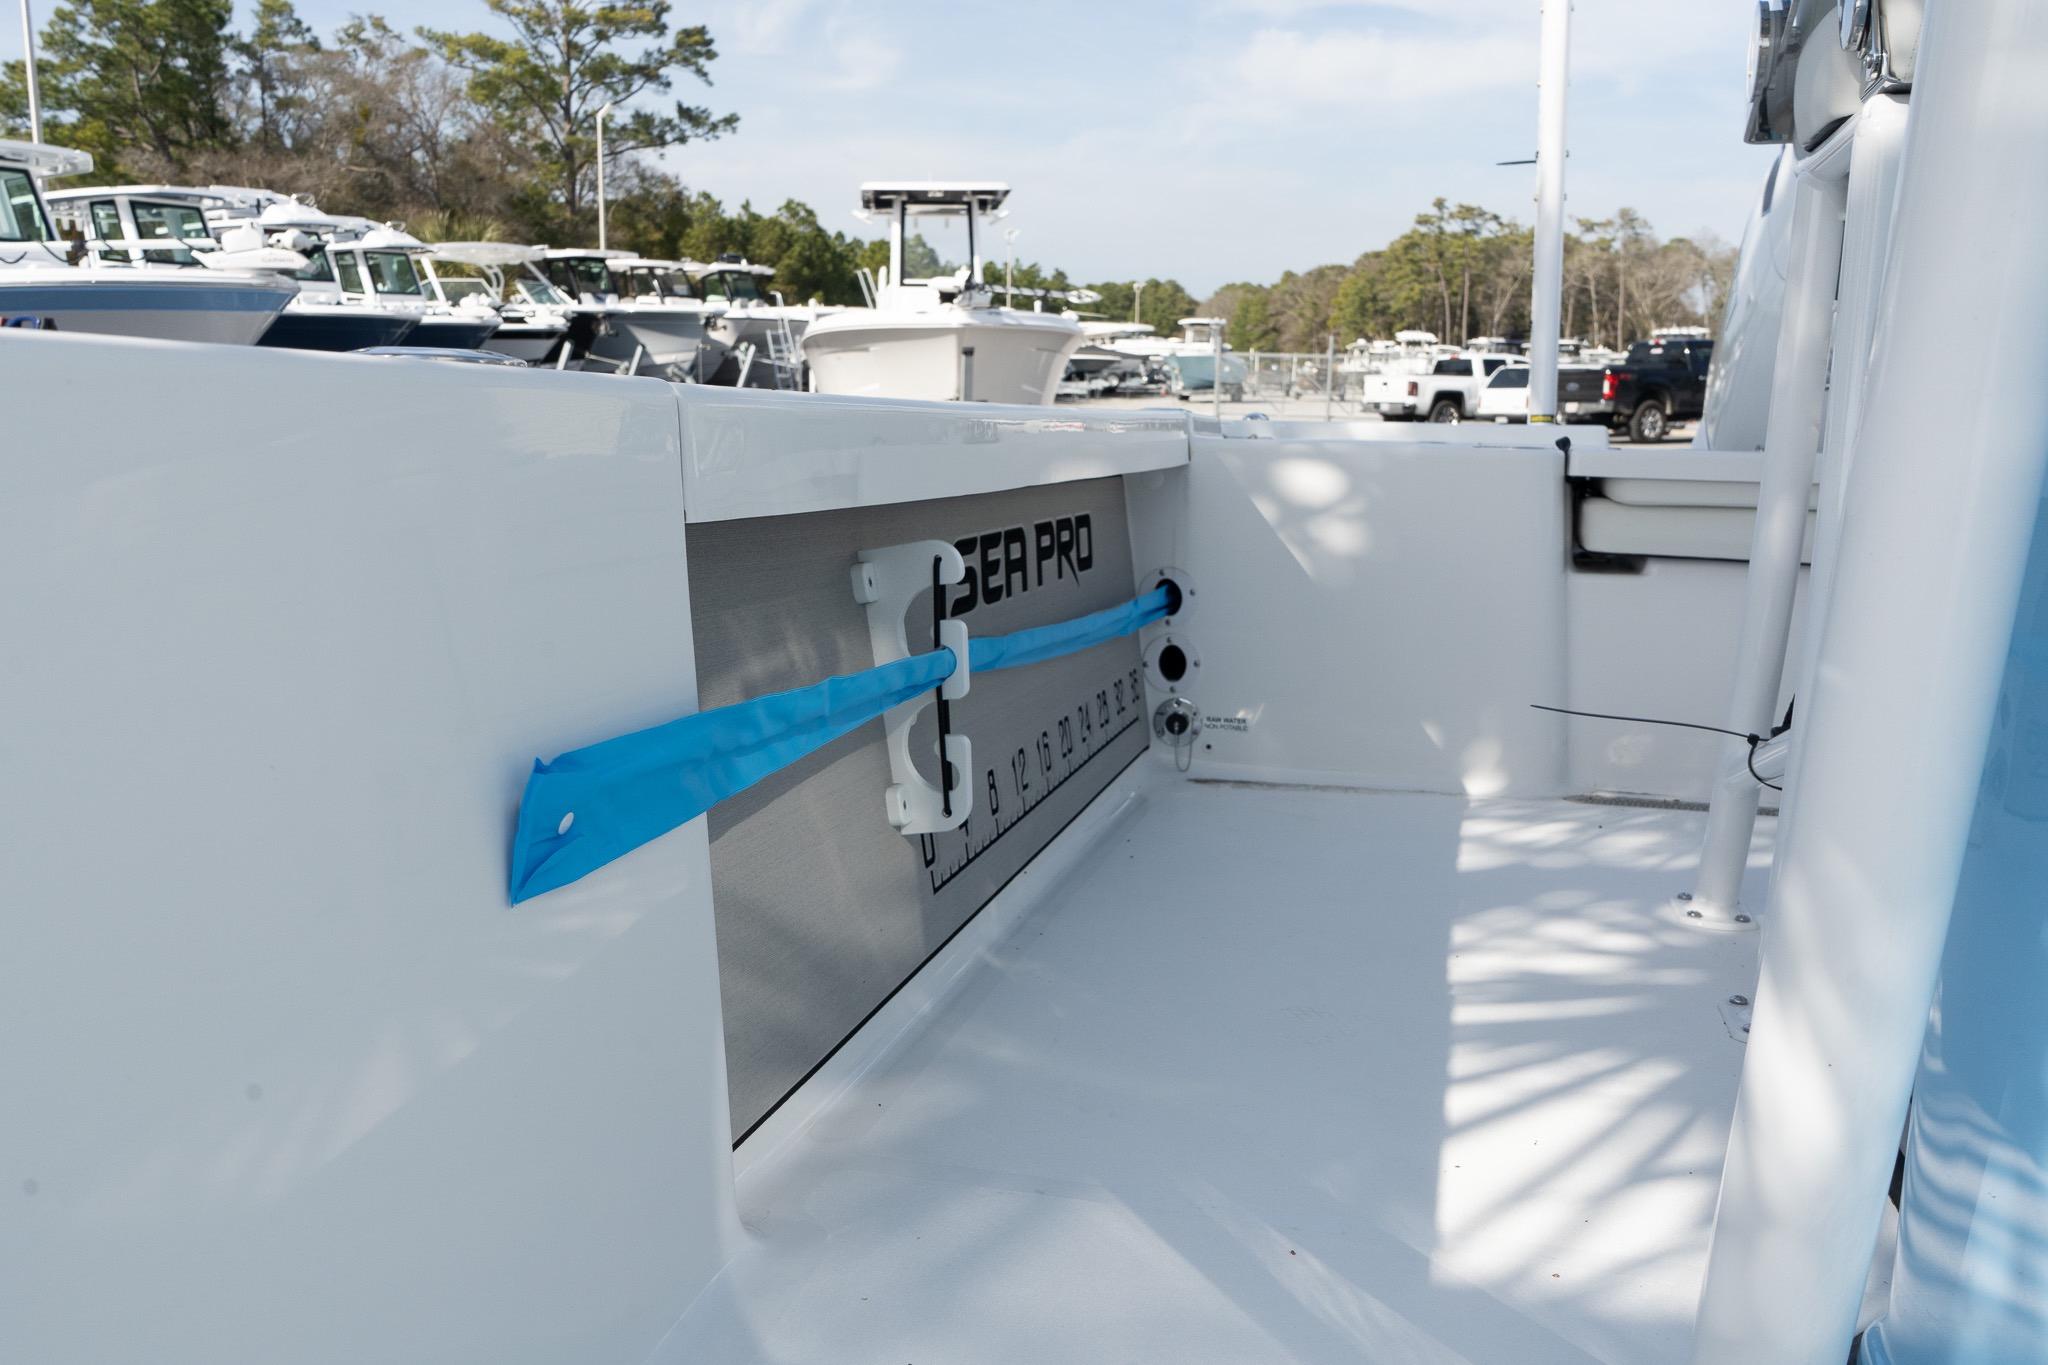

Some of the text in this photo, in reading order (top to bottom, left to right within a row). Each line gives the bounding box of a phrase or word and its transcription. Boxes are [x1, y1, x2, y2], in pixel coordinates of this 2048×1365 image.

[951, 513, 1093, 618] SEA PRO
[987, 768, 999, 816] 8
[1012, 747, 1029, 796] 12
[1036, 730, 1052, 777] 16
[1058, 715, 1073, 759] 20
[1078, 701, 1092, 743] 24
[1096, 689, 1110, 729] 28
[1113, 678, 1126, 716] 32
